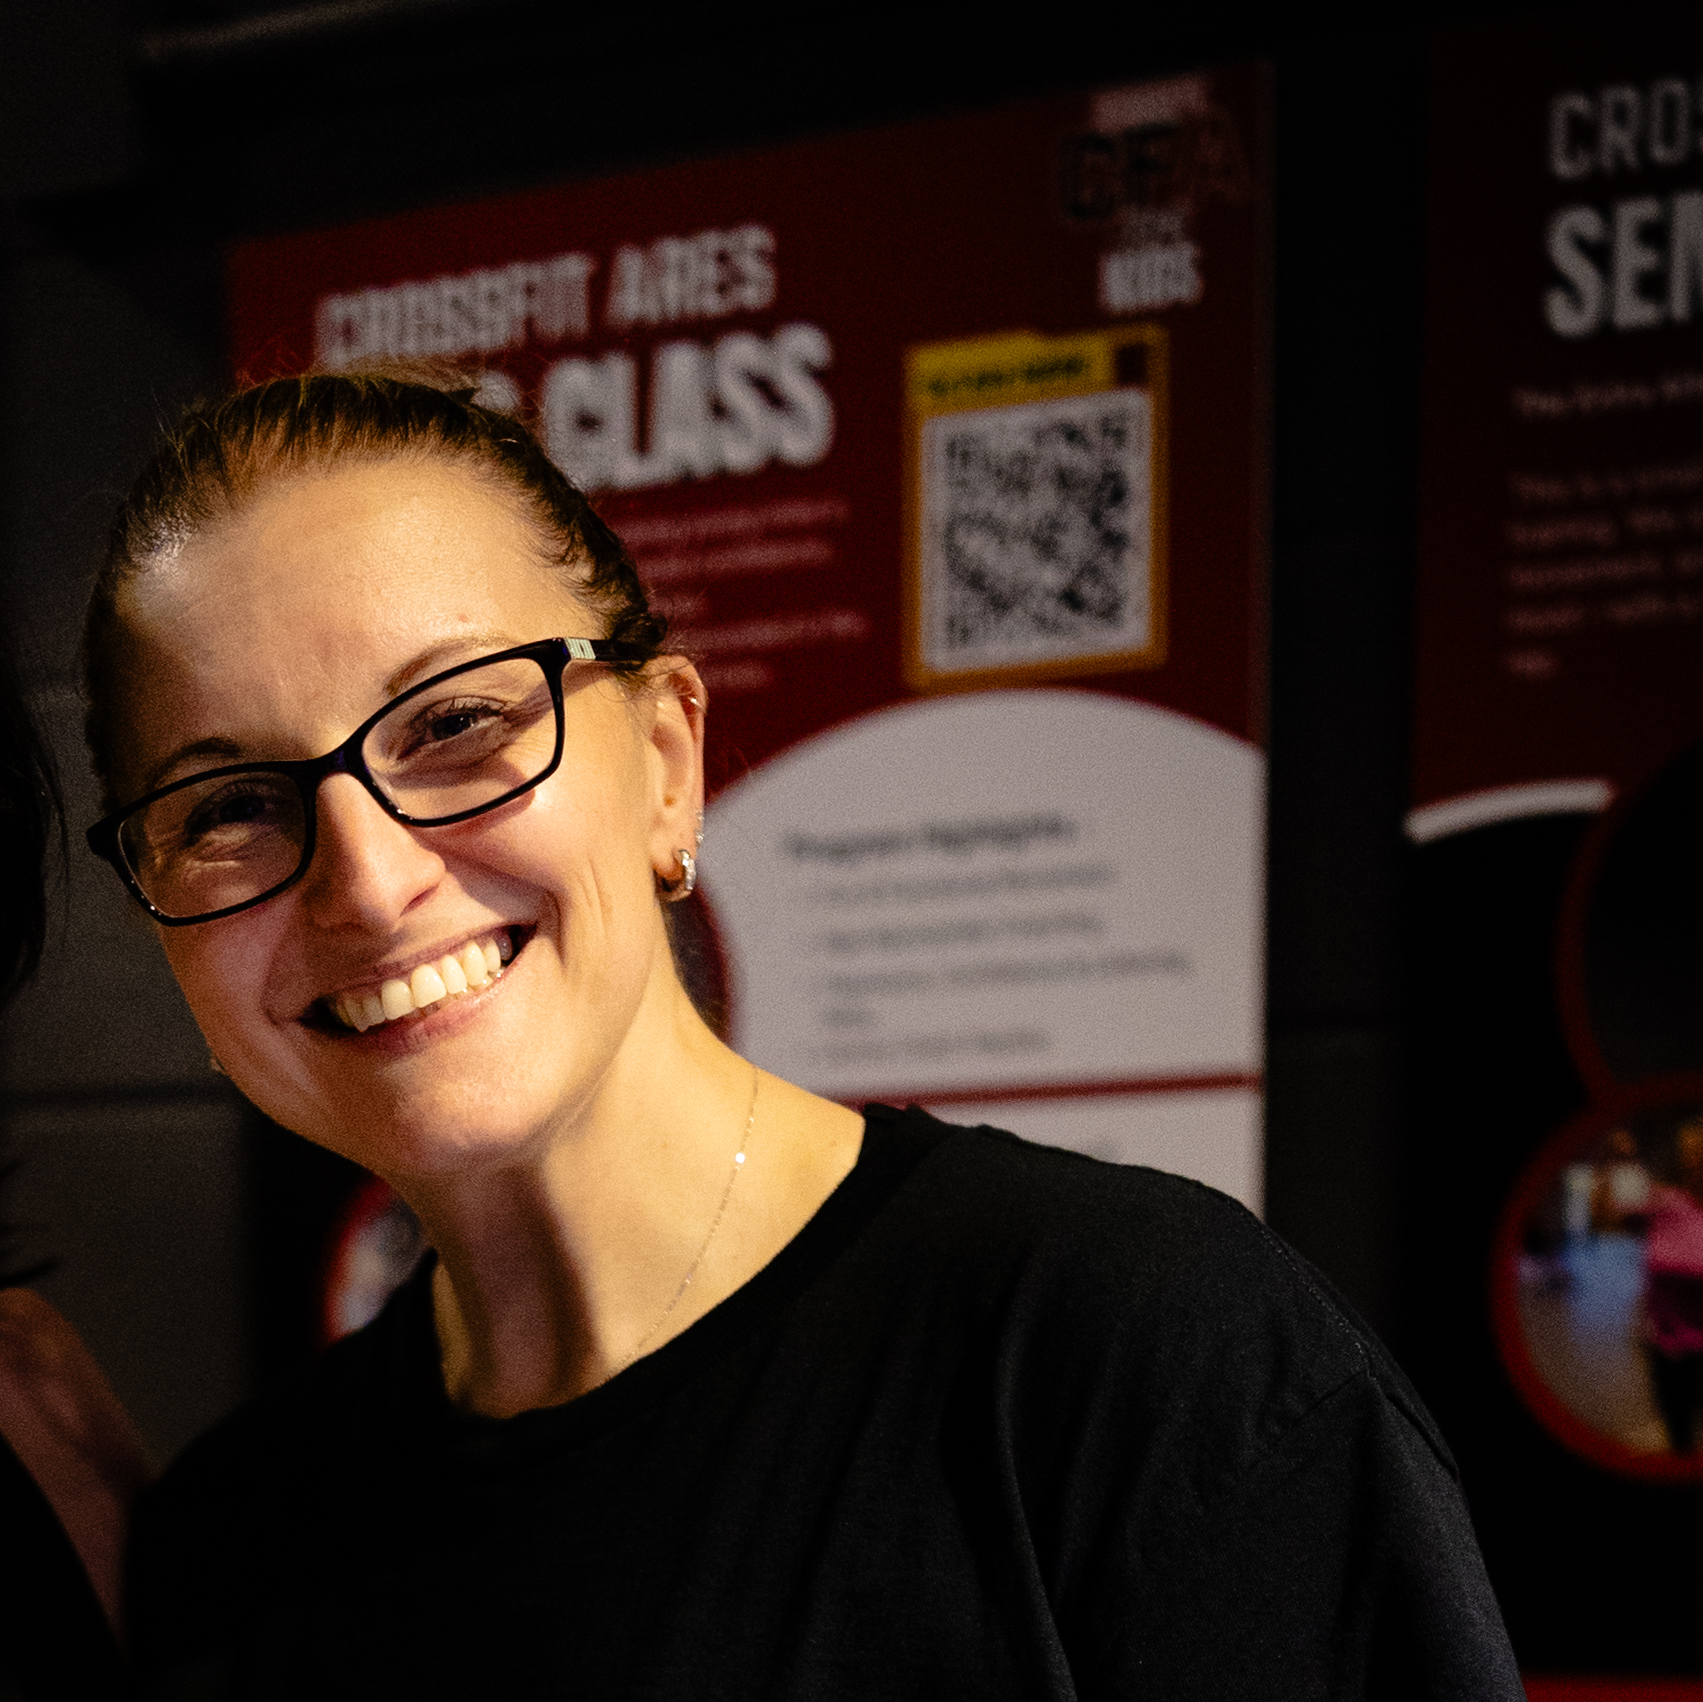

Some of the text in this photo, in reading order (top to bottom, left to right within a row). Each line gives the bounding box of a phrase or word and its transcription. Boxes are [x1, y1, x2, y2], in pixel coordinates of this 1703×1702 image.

[1548, 77, 1703, 180] CRO
[316, 222, 778, 372] CROSSFIT ARES
[541, 320, 836, 492] CLASS
